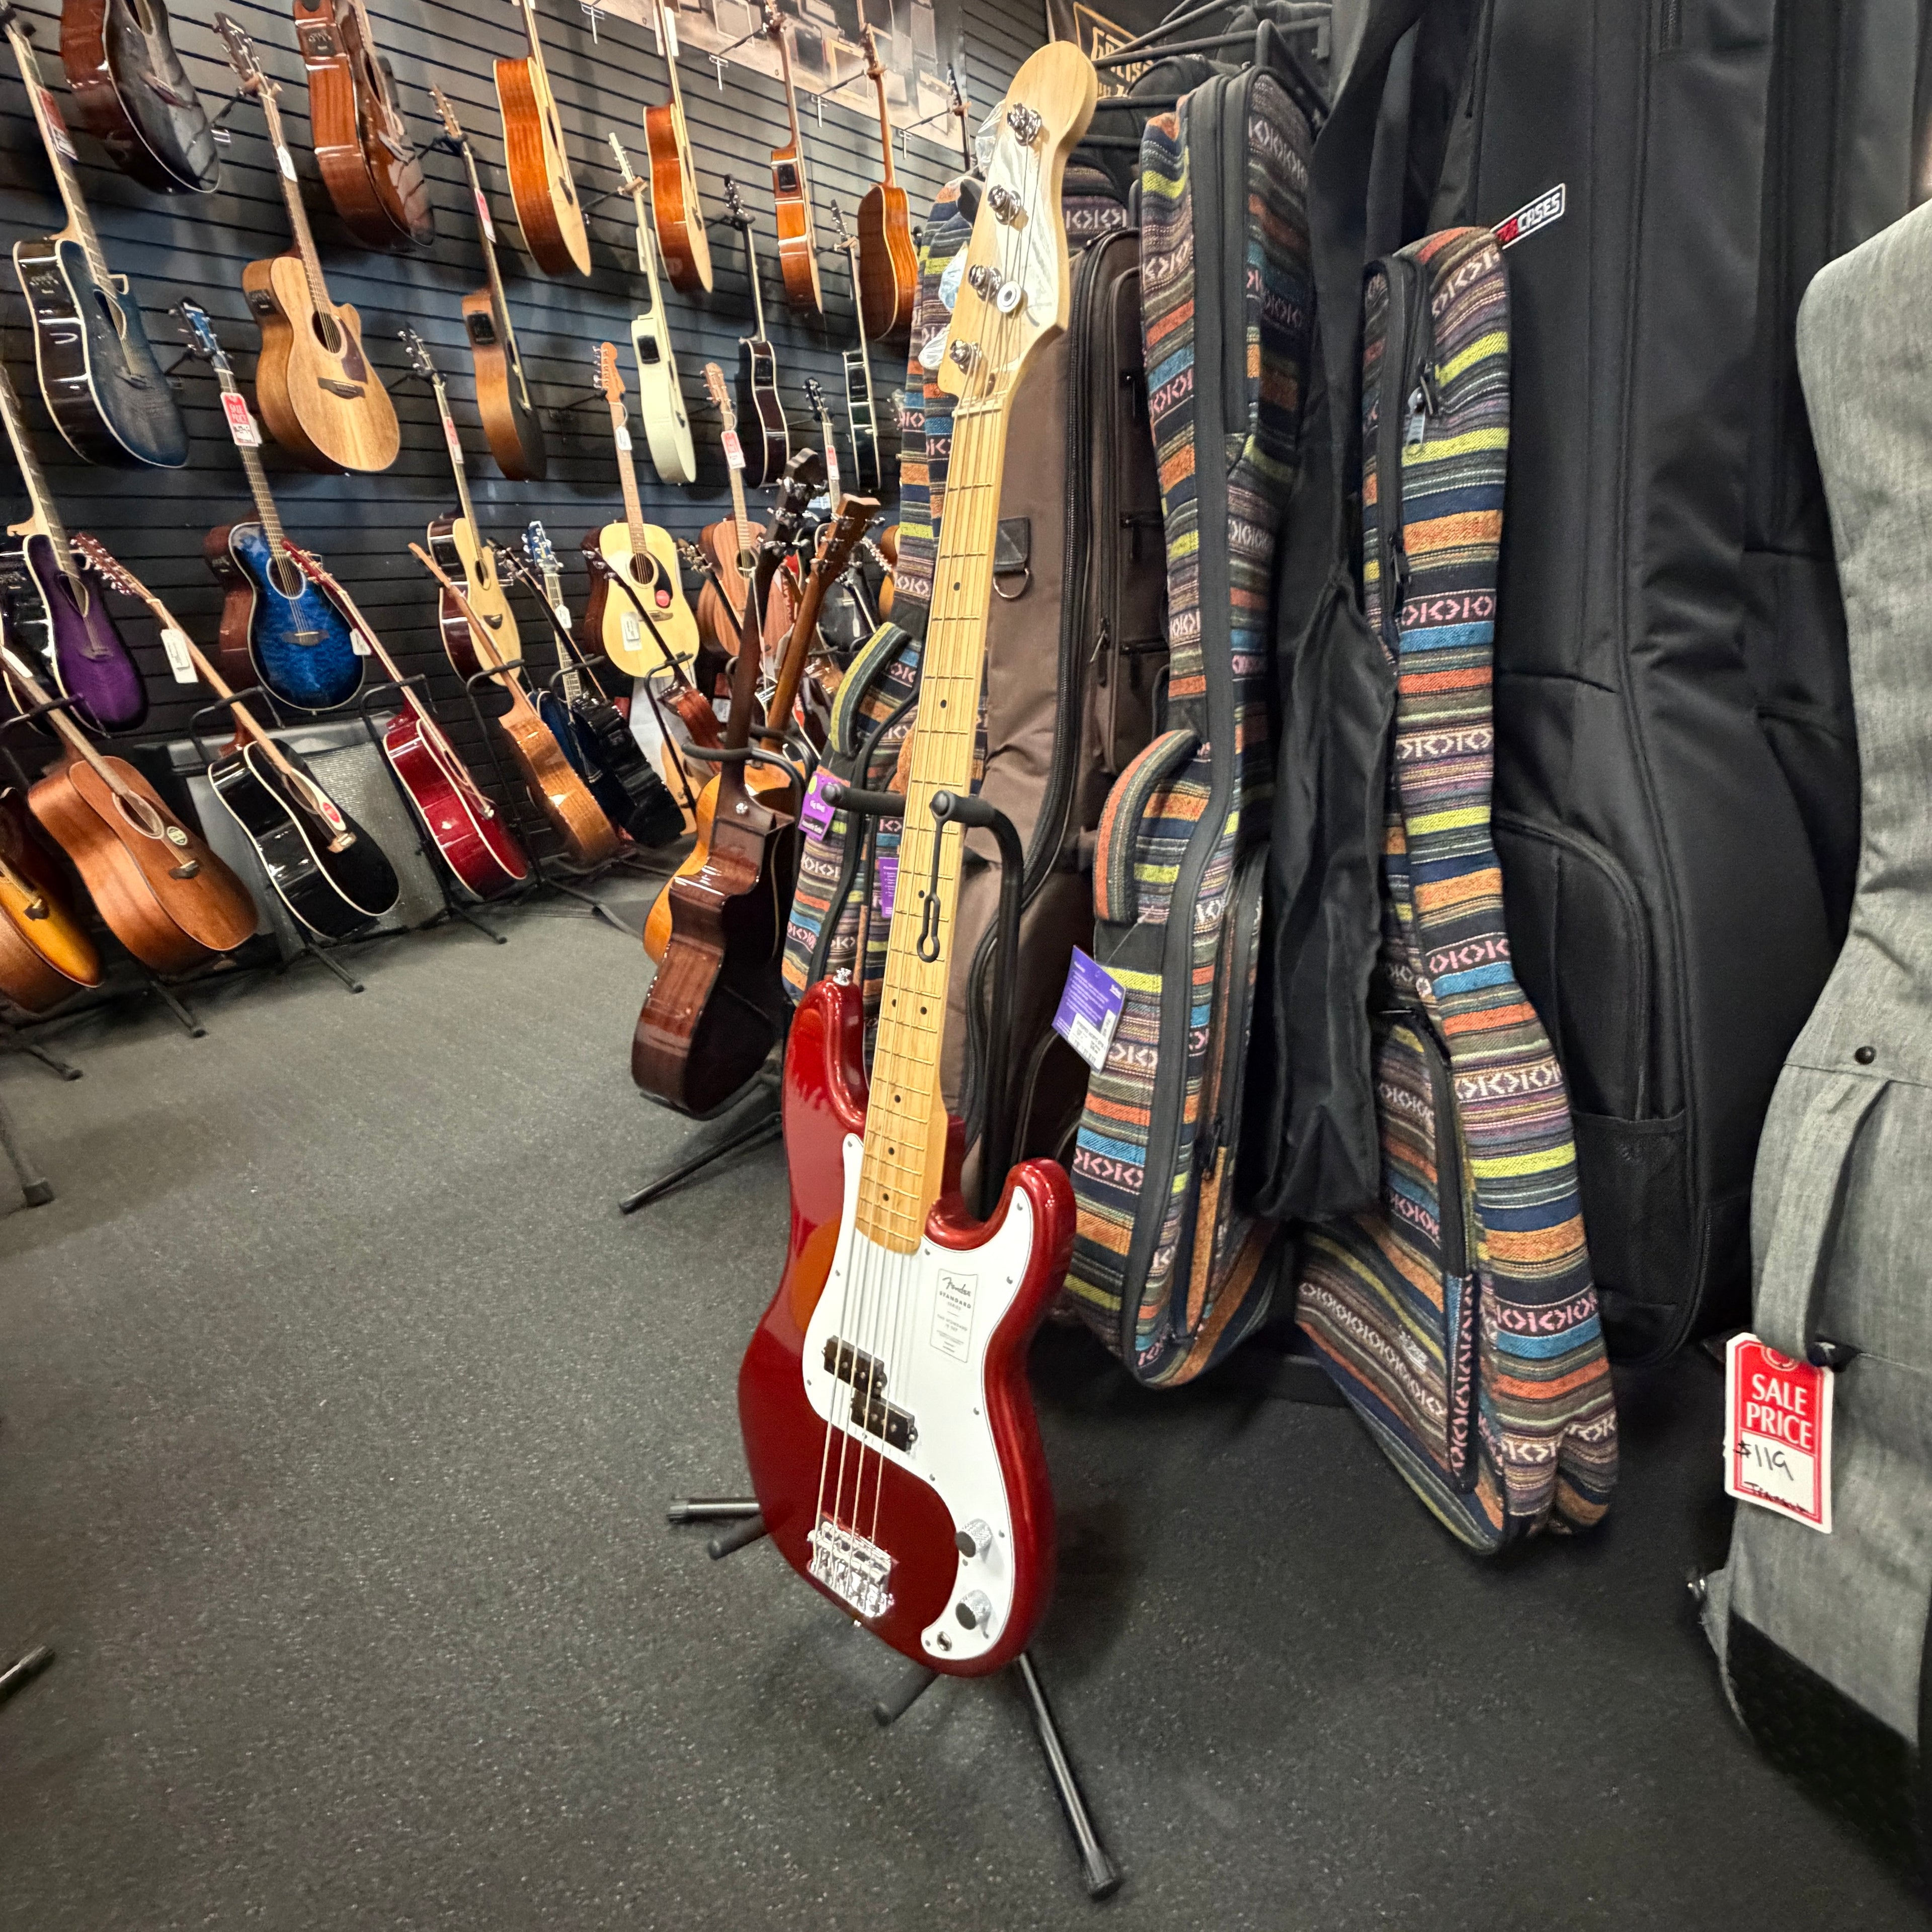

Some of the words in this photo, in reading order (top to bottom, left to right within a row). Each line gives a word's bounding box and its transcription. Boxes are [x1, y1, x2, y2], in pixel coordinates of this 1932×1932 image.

[1517, 192, 1560, 233] CASES
[939, 1291, 972, 1309] STANDARD
[942, 1277, 972, 1297] Fender
[1751, 1374, 1807, 1416] SALE
[1746, 1401, 1812, 1450] PRICE
[1733, 1440, 1794, 1481] $119
